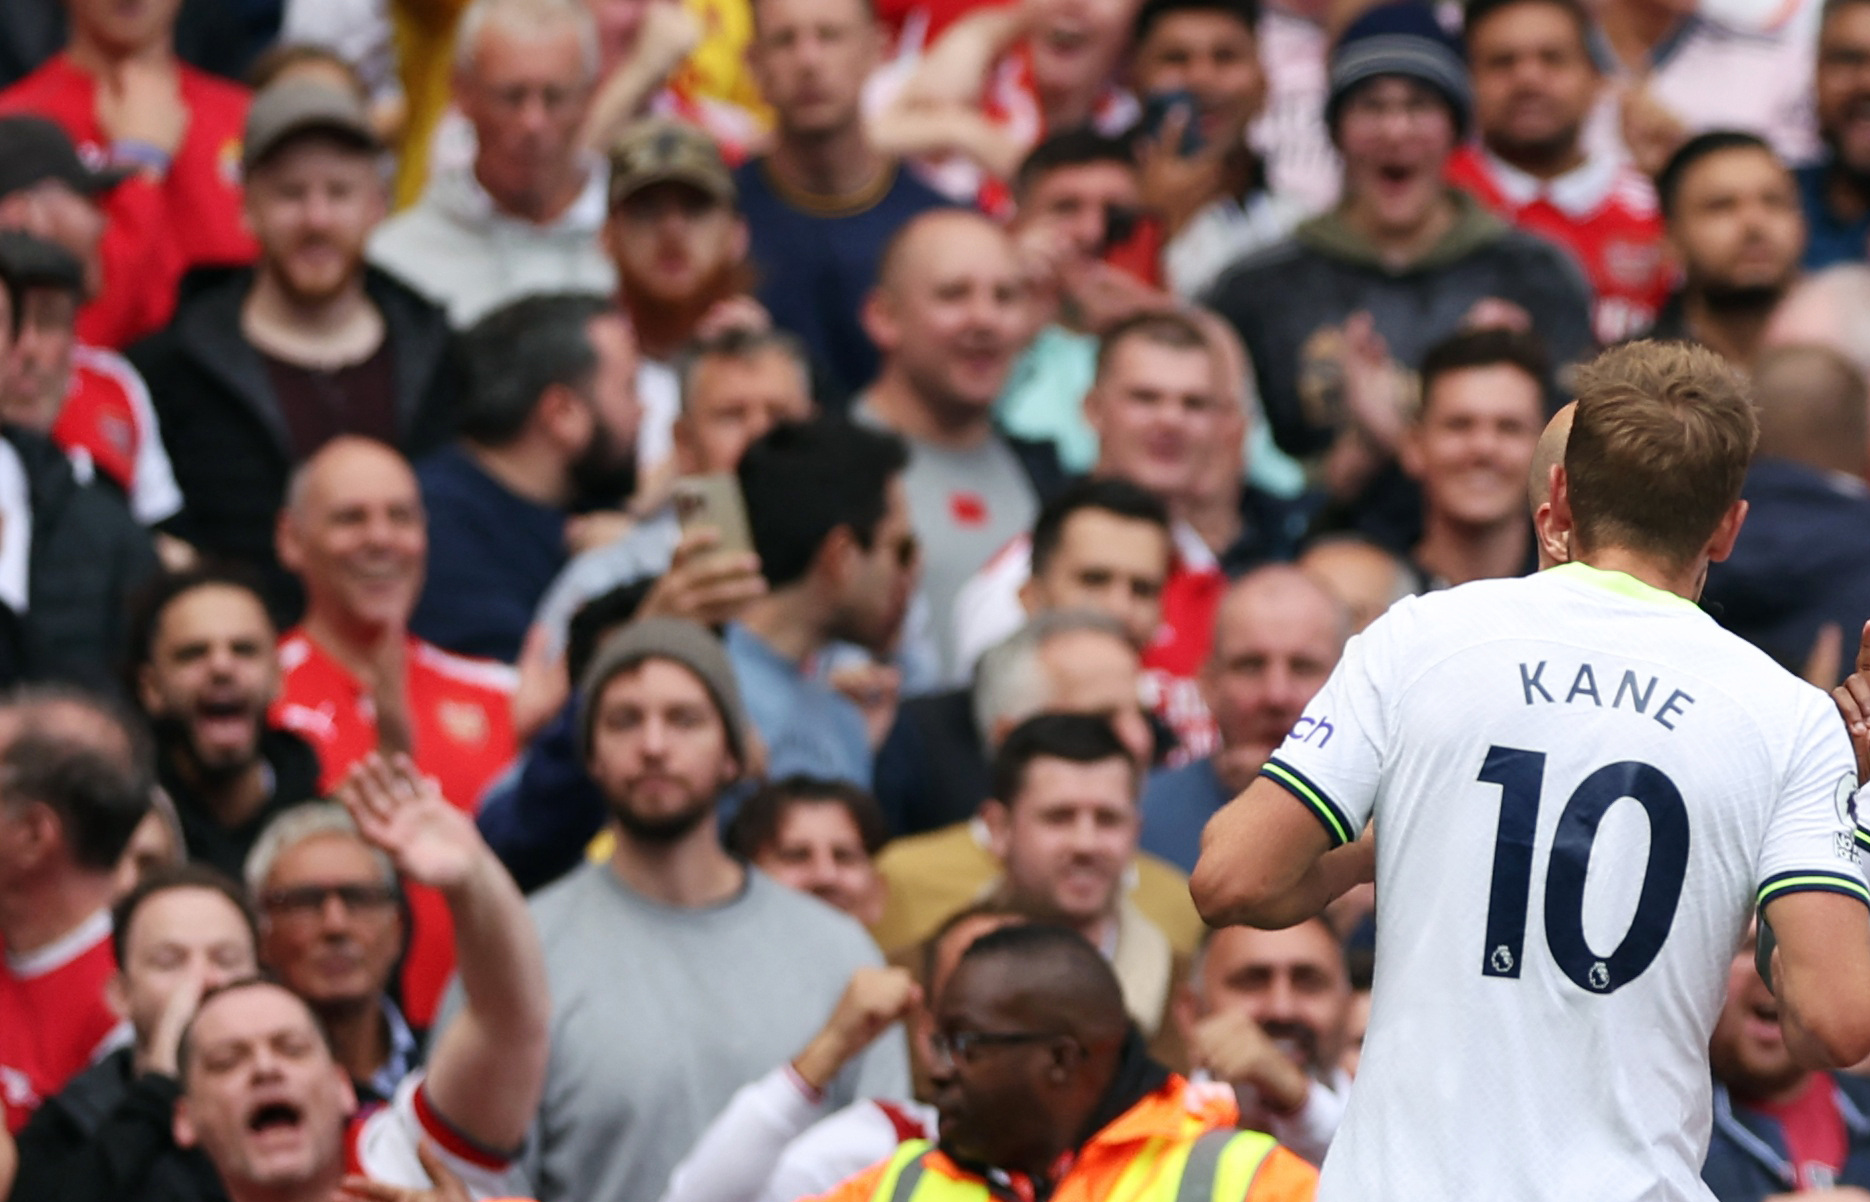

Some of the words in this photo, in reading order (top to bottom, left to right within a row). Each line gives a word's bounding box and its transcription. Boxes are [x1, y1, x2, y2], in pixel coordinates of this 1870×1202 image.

[1519, 660, 1696, 731] KANE
[1288, 715, 1335, 749] ch
[1477, 745, 1691, 994] 10
